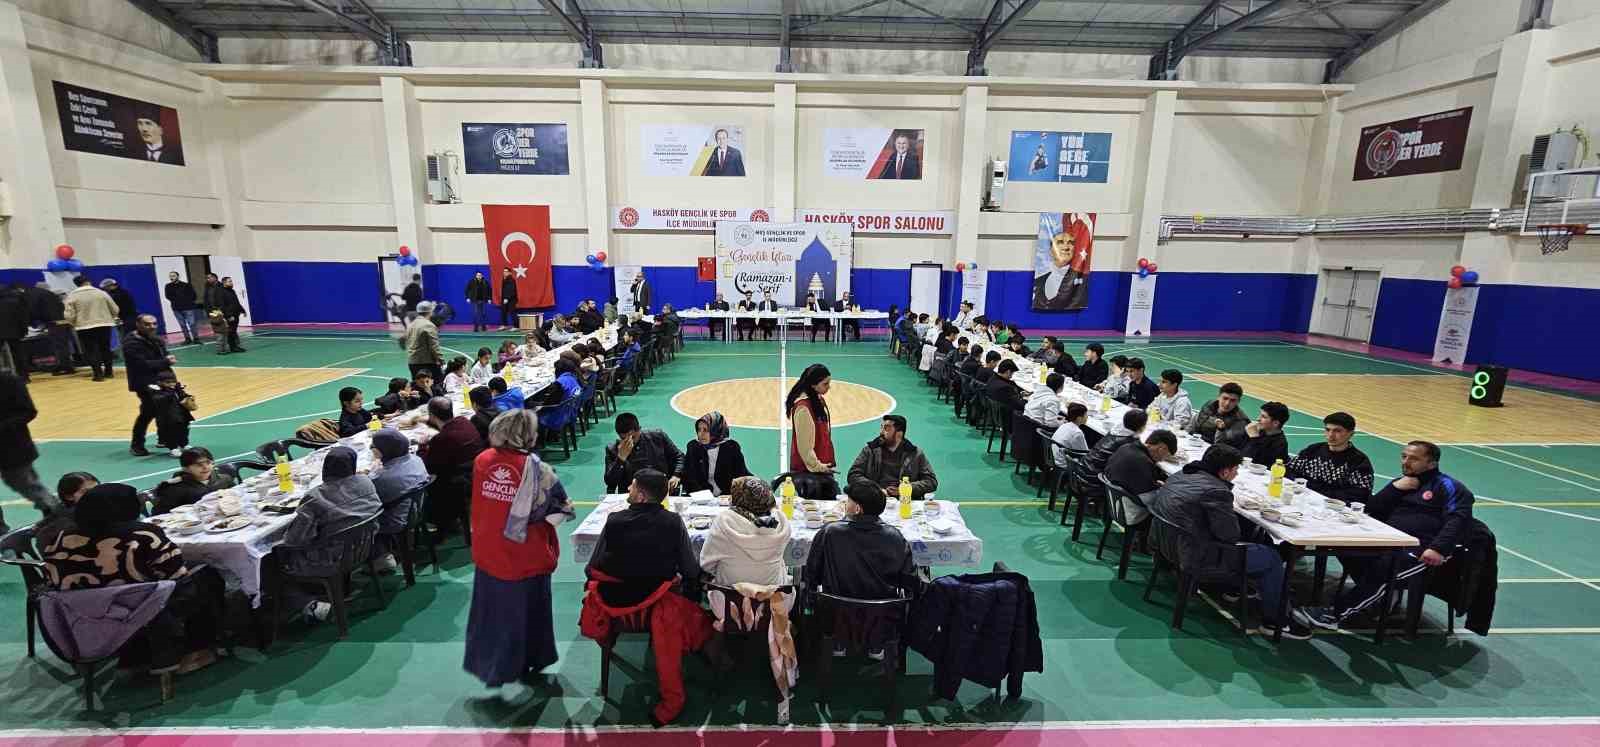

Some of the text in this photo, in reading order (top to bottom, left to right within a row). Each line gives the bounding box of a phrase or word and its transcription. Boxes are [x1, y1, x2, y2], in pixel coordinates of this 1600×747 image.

[1413, 141, 1443, 158] YERDE
[652, 207, 737, 219] HASKÖY GENÇLİK VE SPOR
[666, 218, 681, 229] İLÇE
[858, 215, 891, 230] SPOR
[894, 216, 945, 231] SALONU
[740, 272, 792, 284] Ramazan-ı
